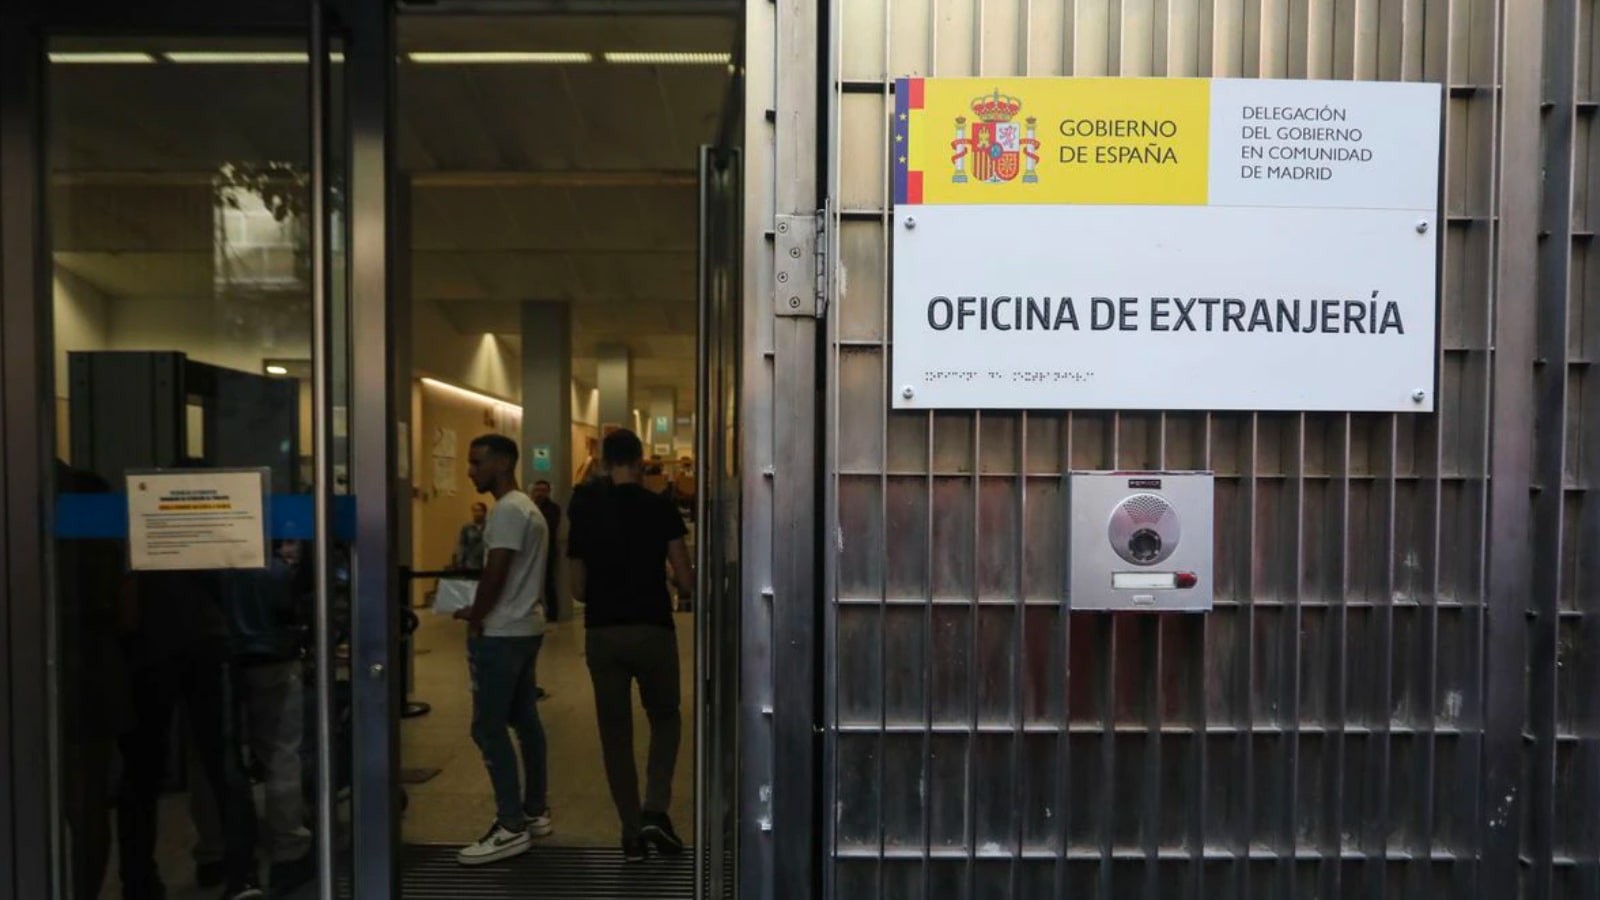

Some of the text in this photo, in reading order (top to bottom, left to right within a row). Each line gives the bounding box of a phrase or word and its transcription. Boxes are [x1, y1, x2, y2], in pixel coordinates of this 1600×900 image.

[1243, 106, 1346, 121] DELEGACIÓN
[1060, 120, 1177, 137] GOBIERNO
[1242, 126, 1362, 141] DEL GOBIERNO
[1060, 143, 1177, 164] DE ESPAÑA
[1242, 146, 1372, 161] EN COMUNIDAD
[1241, 166, 1332, 180] DE MADRID
[928, 290, 1404, 335] OFICINA DE EXTRANJERÍA
